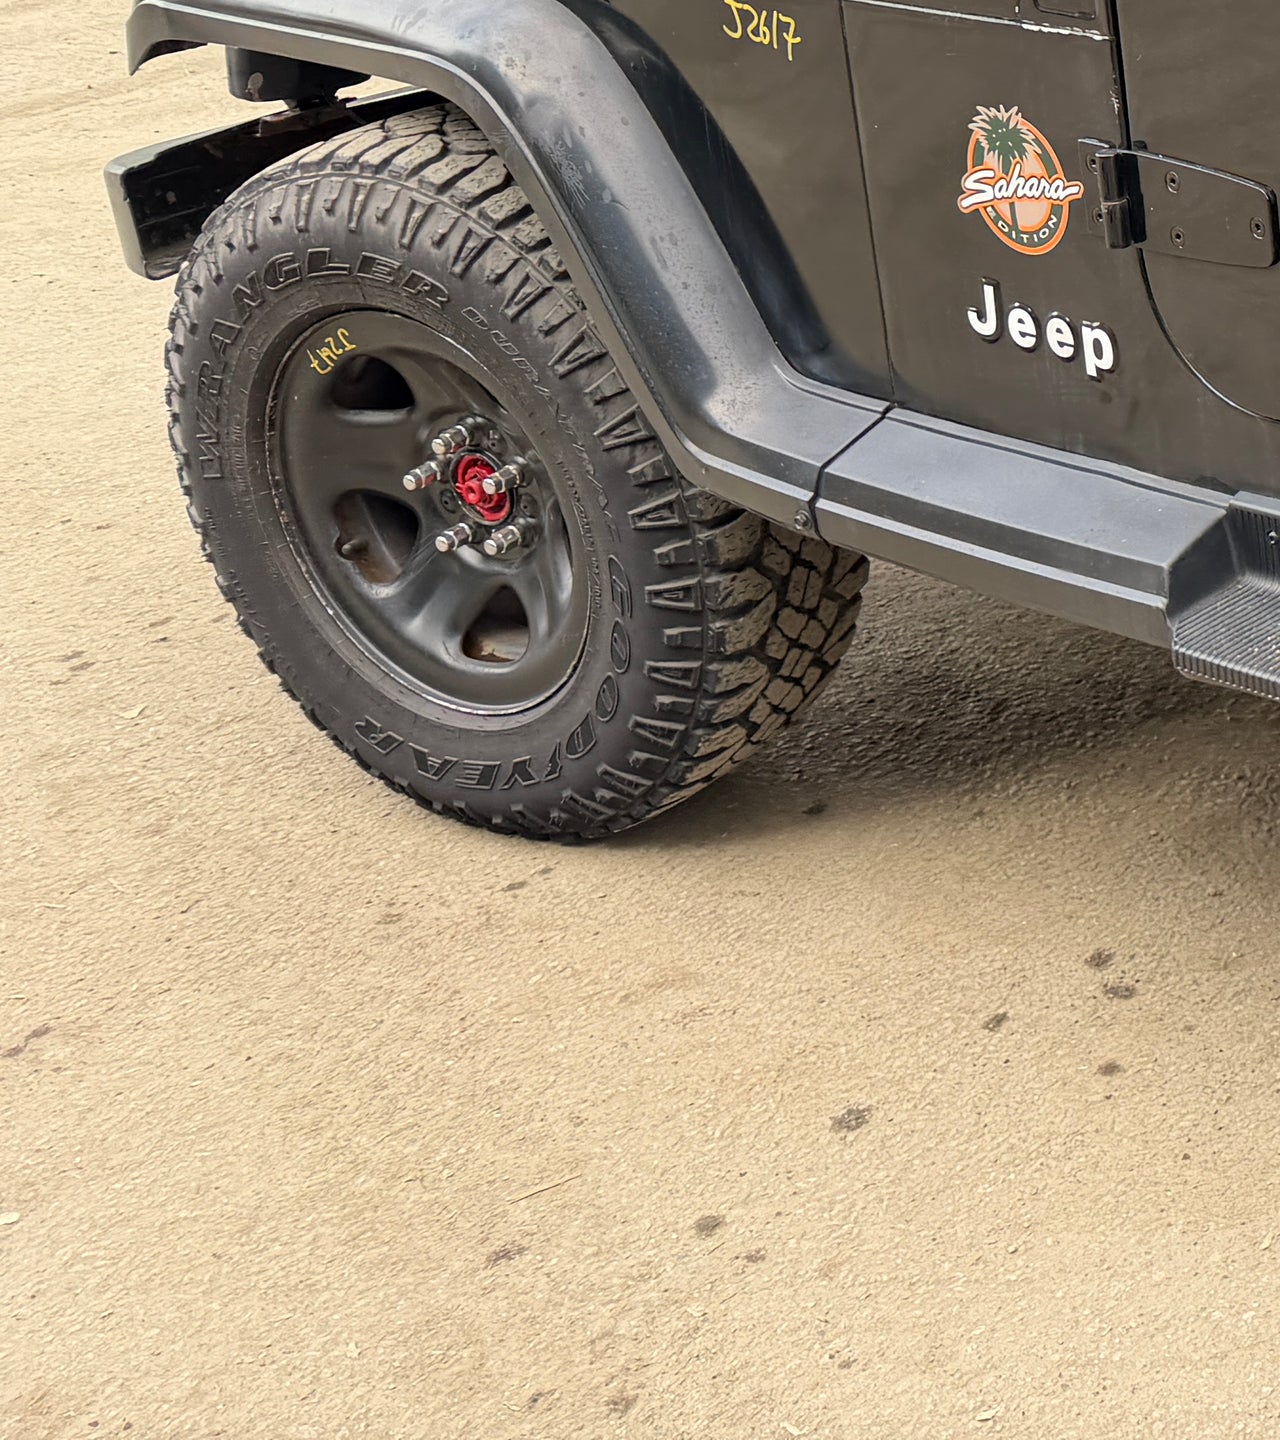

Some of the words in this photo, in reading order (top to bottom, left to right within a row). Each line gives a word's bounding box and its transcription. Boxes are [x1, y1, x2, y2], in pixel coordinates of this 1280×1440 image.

[958, 162, 1083, 210] Sahara
[985, 205, 1059, 244] EDITION
[195, 246, 450, 480] WRANGLER
[966, 277, 1118, 381] Jeep
[354, 553, 633, 791] GOODYEAR
